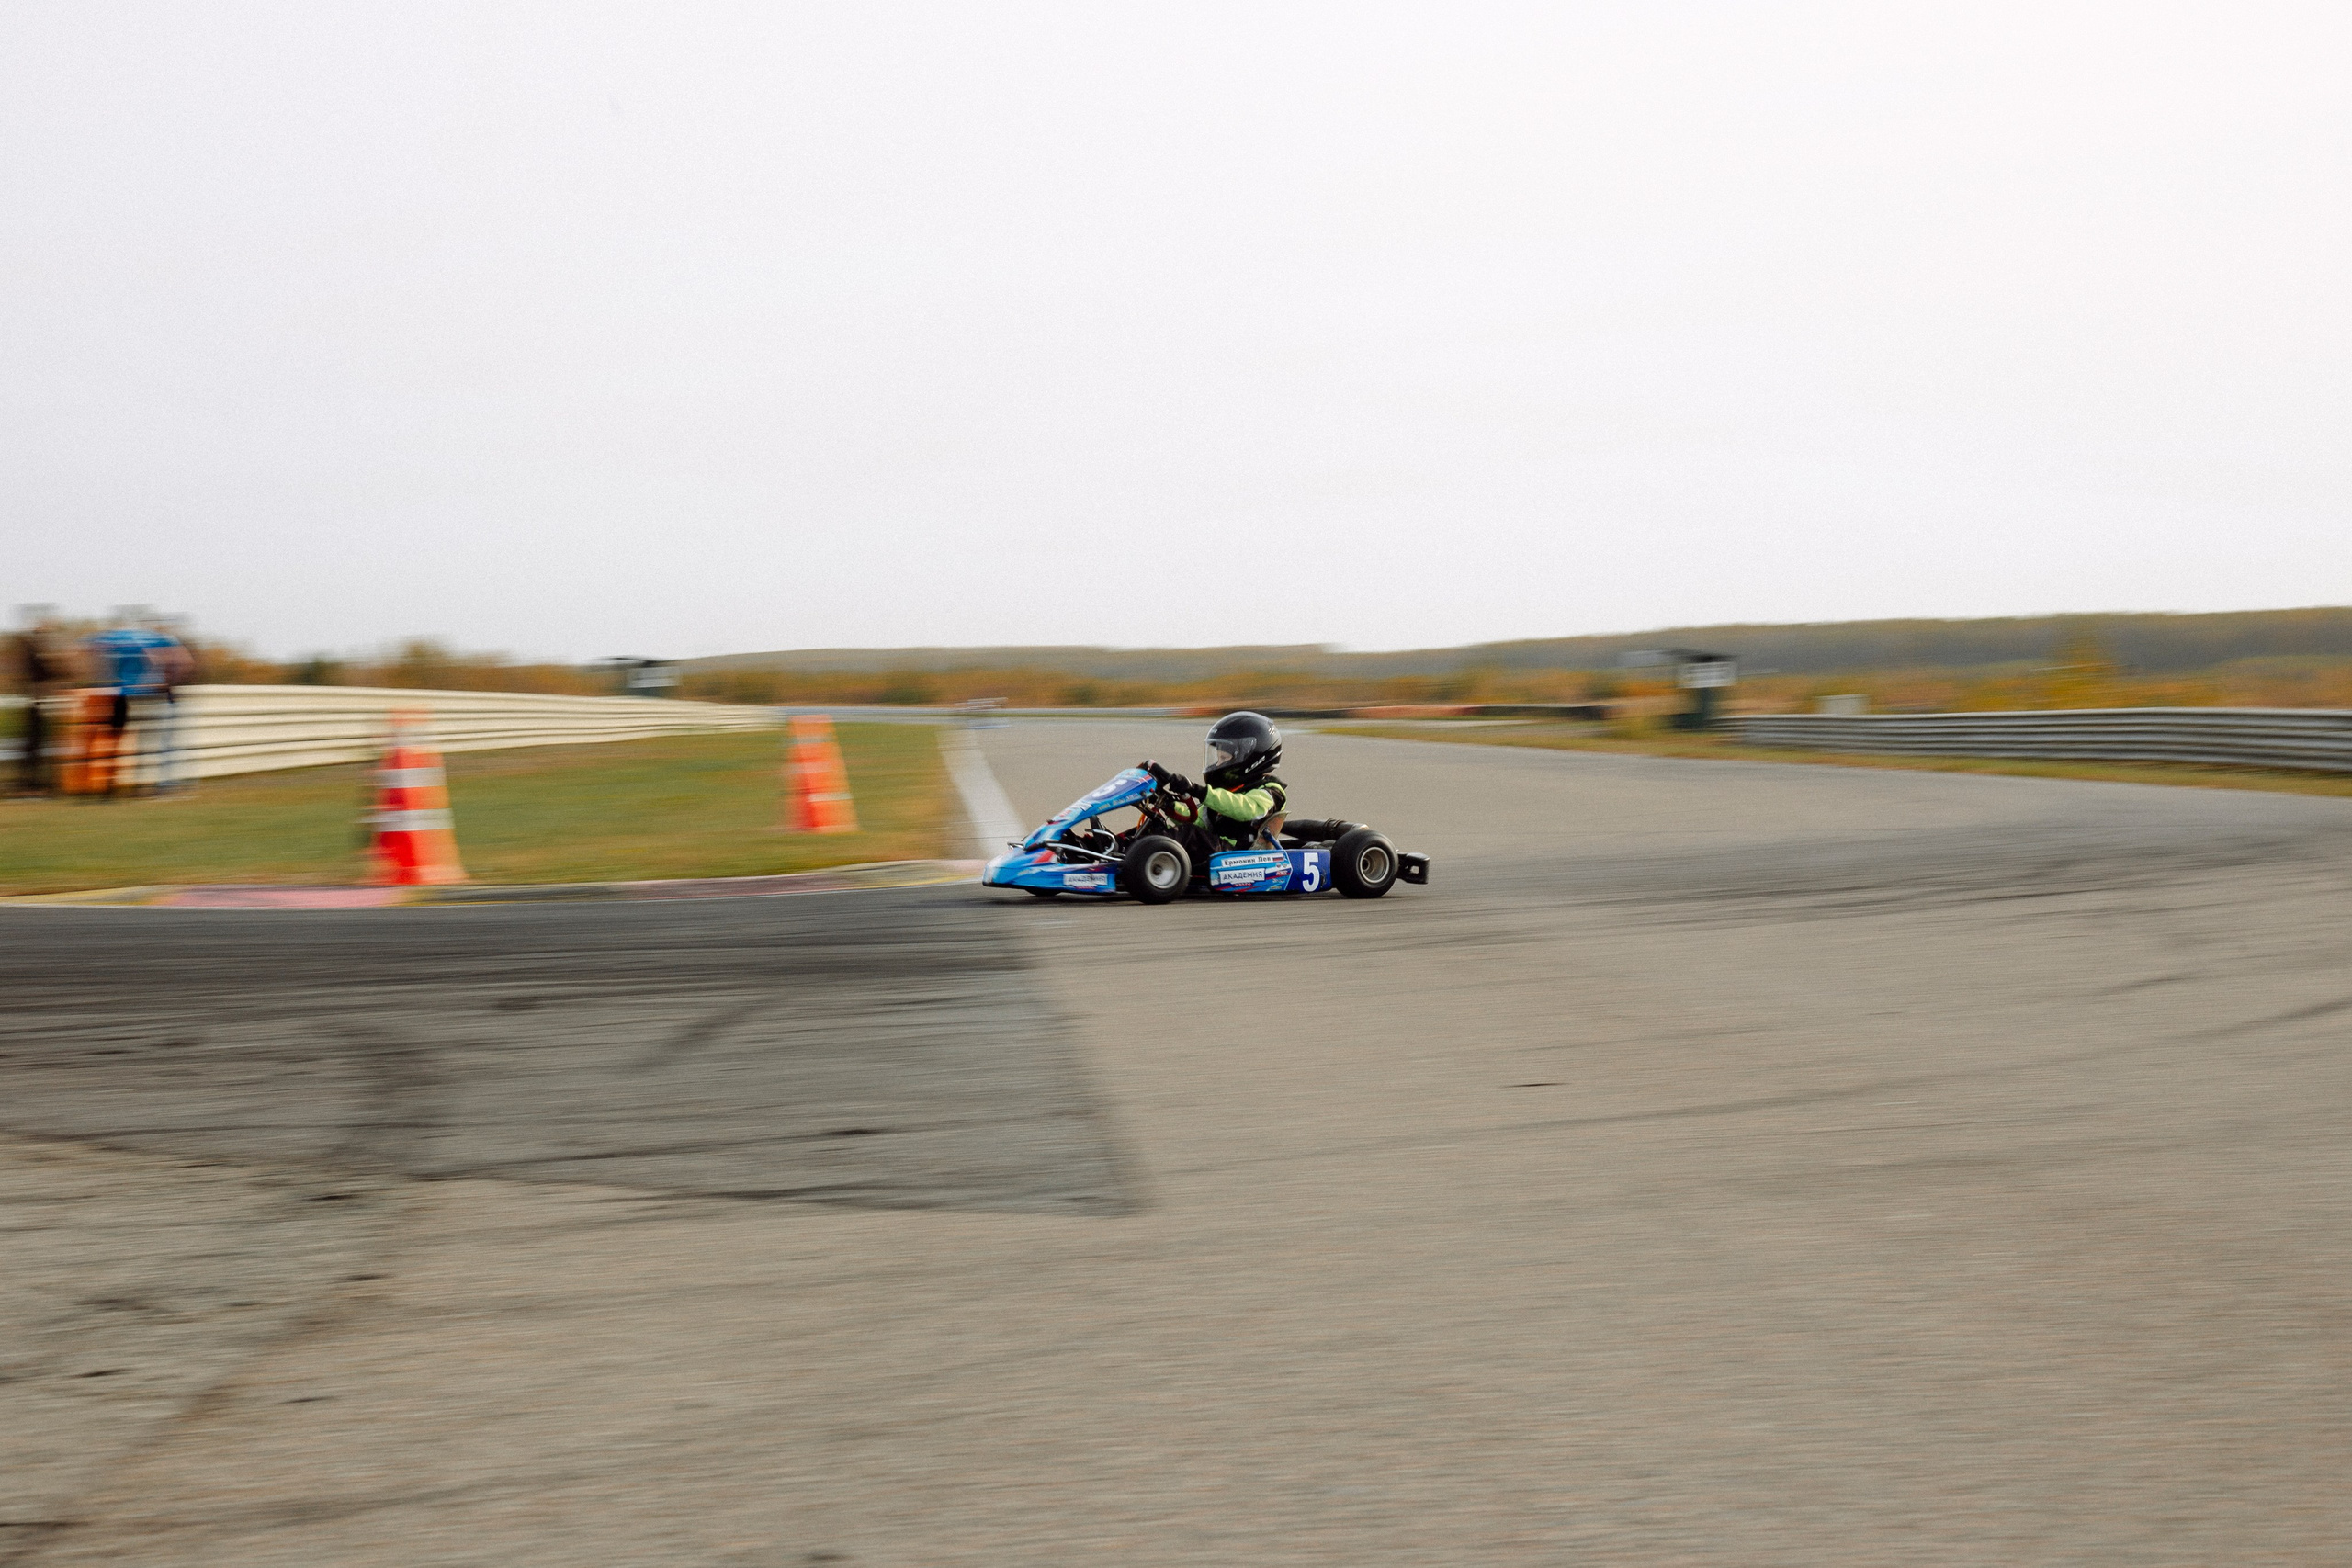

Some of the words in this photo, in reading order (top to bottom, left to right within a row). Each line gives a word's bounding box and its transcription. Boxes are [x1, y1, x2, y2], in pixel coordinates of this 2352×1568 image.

[1244, 755, 1266, 774] LS2
[1223, 871, 1263, 881] АКАДЕМИЯ
[1302, 852, 1320, 892] 5
